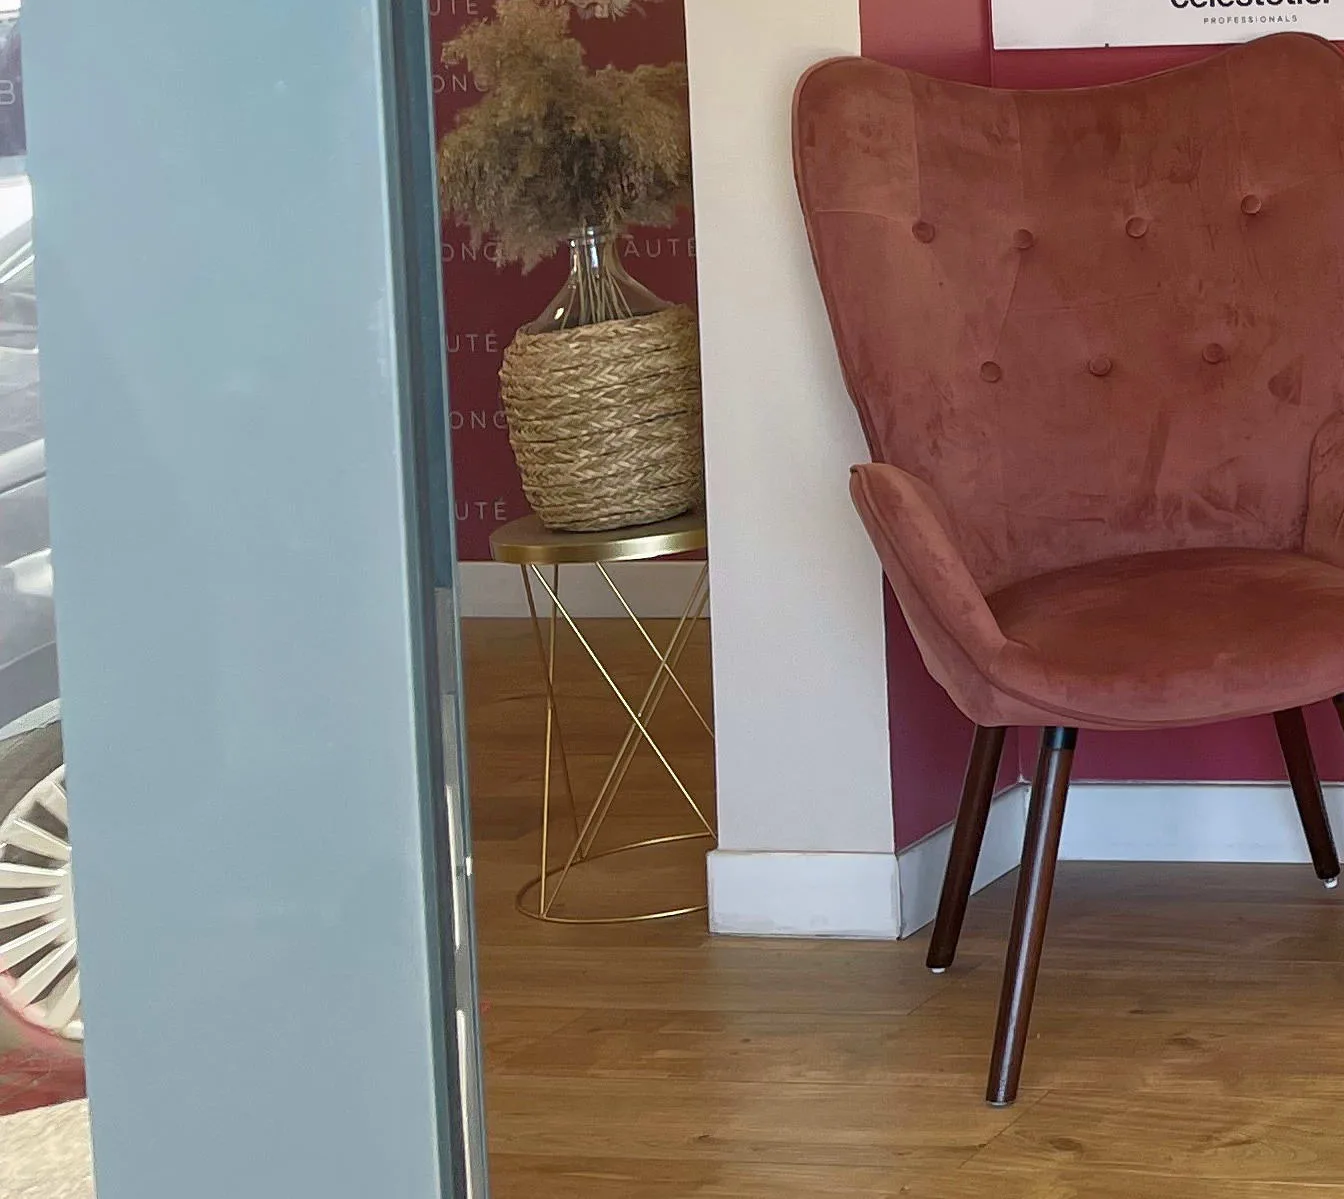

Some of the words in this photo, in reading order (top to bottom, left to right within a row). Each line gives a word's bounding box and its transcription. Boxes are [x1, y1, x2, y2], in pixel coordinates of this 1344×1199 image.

[1203, 14, 1298, 25] PROFESSIONALS
[446, 329, 498, 353] UTÉ
[454, 498, 508, 521] UTÉ
